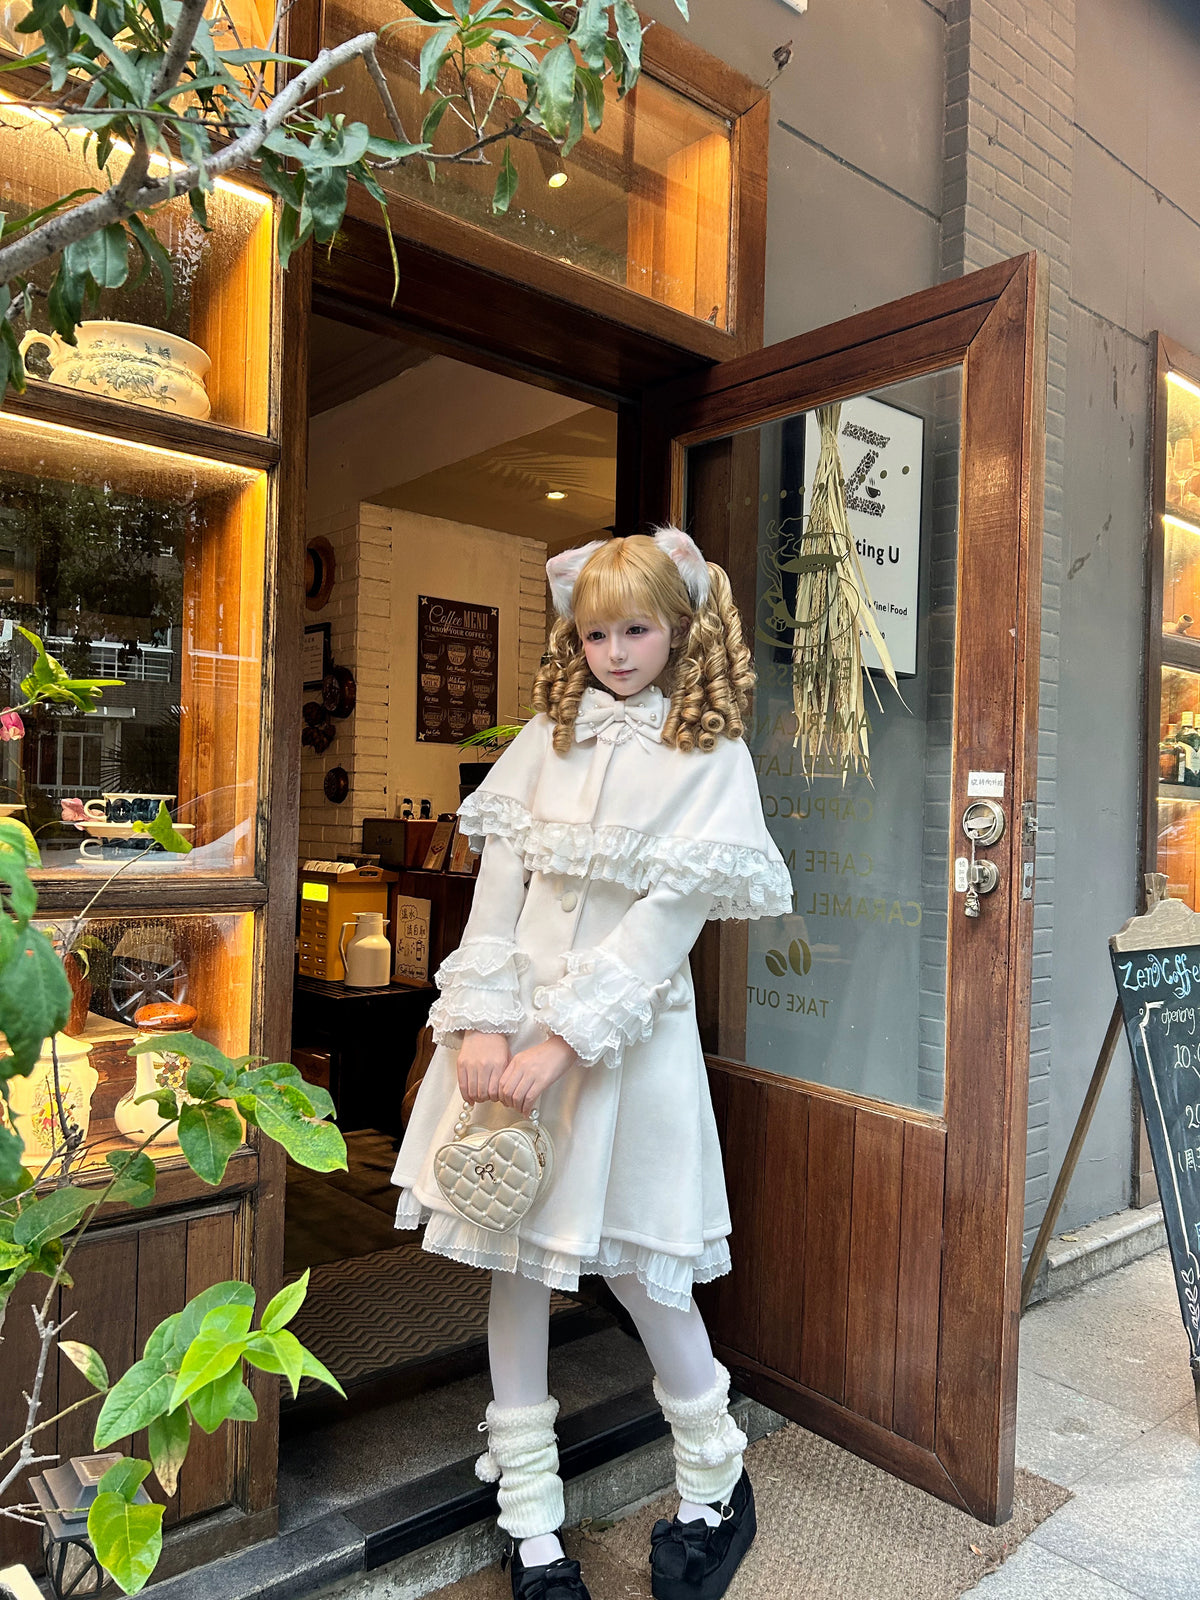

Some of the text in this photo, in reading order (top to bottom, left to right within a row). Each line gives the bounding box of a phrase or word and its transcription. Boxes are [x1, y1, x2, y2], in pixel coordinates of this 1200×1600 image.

[853, 536, 900, 566] ting U
[429, 604, 489, 631] Coffee MENU
[890, 604, 908, 616] Food
[449, 628, 464, 637] YOUR
[464, 630, 486, 639] COFFEE
[1162, 953, 1200, 999] Coffe
